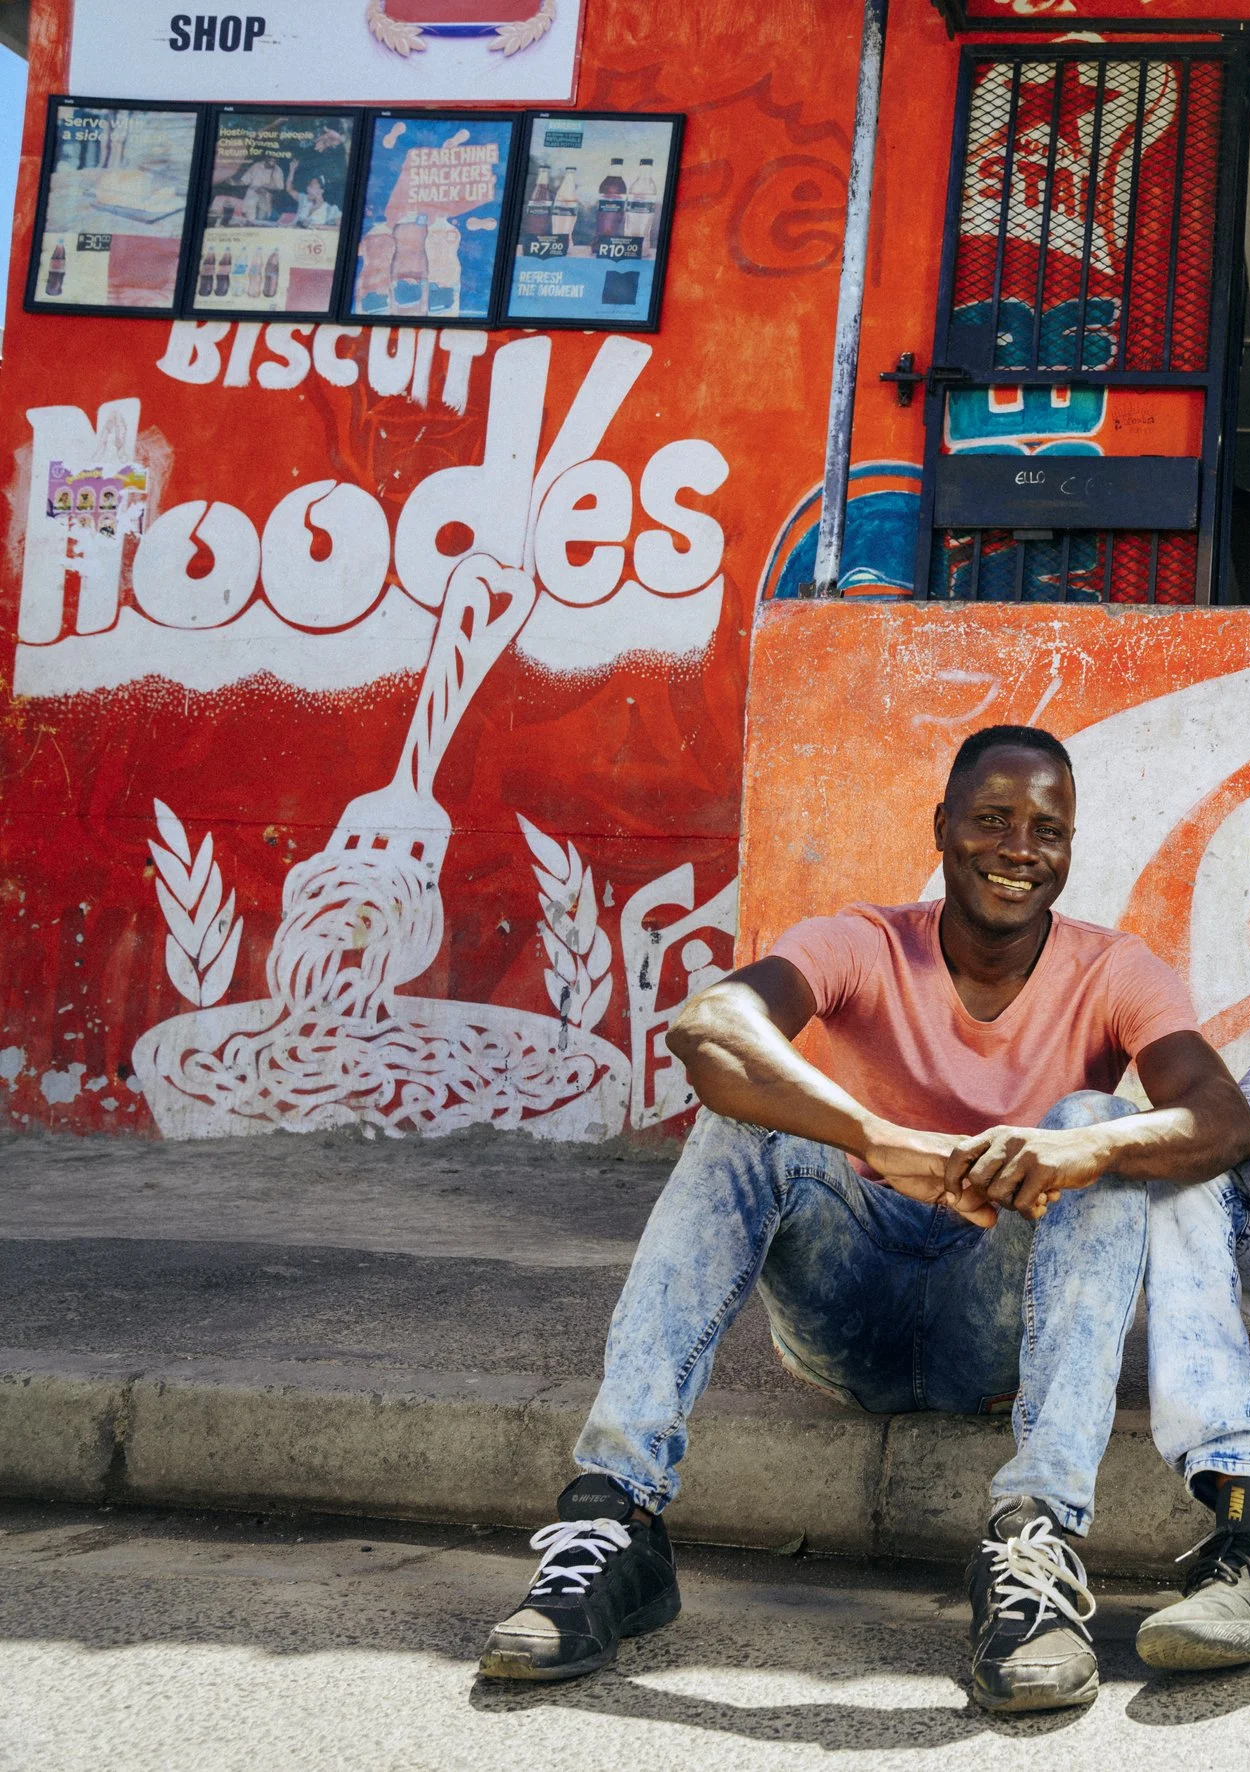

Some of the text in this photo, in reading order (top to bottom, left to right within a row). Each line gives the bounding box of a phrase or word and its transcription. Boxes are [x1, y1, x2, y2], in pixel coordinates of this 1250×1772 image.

[168, 15, 266, 52] SHOP
[64, 113, 106, 128] Serve
[62, 130, 71, 140] a
[75, 129, 107, 141] side
[219, 127, 314, 141] Hosting your people
[218, 146, 292, 159] Return for more
[410, 144, 498, 166] SEARCHING
[407, 182, 495, 204] SNACK UP!
[530, 242, 563, 255] R7.00
[599, 244, 638, 258] R10.00
[519, 271, 563, 283] REFRESH
[518, 284, 585, 298] THE MOMENT
[156, 320, 488, 417] BISCUIT
[18, 335, 730, 646] Noodles
[1228, 1486, 1245, 1522] NIKE
